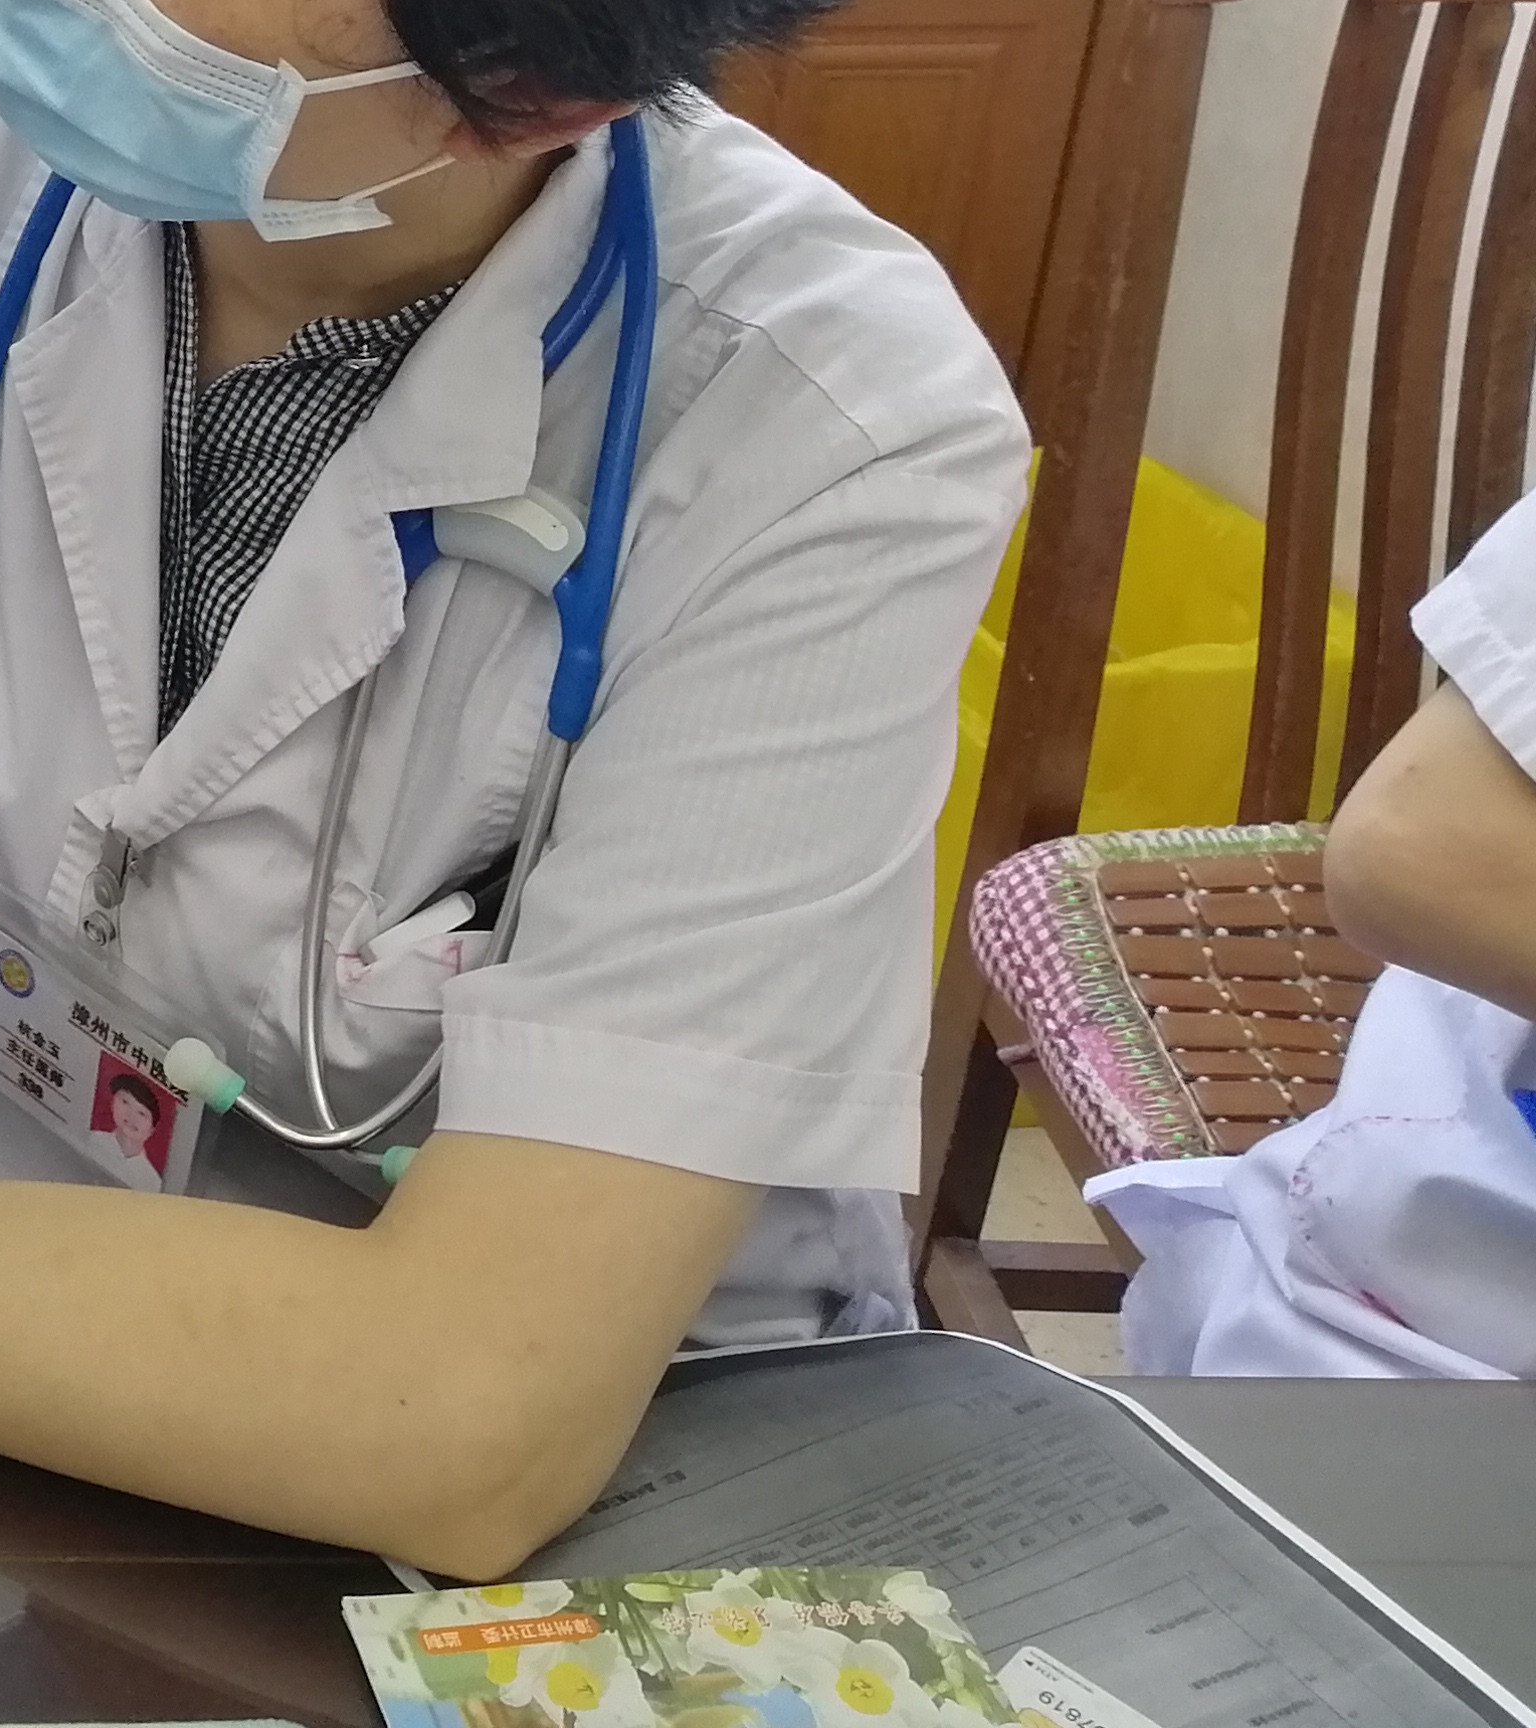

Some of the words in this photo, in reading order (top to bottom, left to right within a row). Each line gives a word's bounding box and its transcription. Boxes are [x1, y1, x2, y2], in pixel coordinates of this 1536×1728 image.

[480, 1617, 593, 1645] 漳州市卫计委
